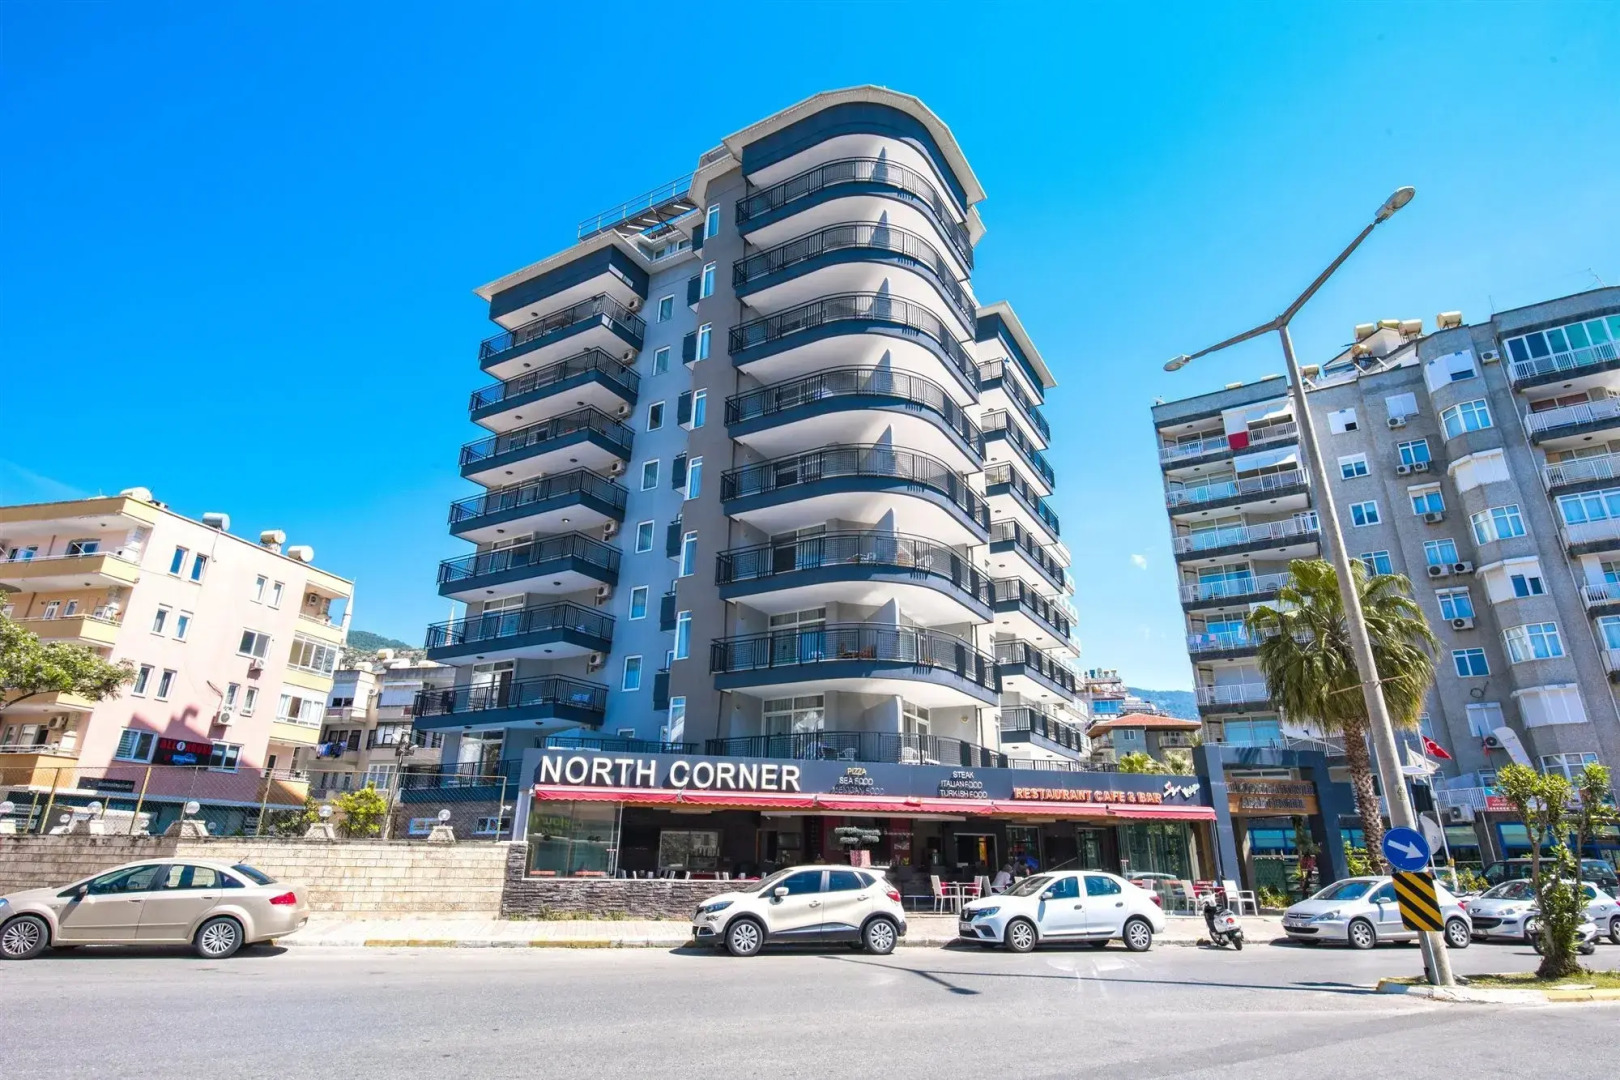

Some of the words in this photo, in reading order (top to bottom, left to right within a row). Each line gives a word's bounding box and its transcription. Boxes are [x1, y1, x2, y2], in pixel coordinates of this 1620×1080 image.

[540, 756, 656, 786] NORTH
[669, 760, 801, 792] CORNER
[847, 767, 867, 776] PIZZA
[952, 770, 975, 779] STEAK
[839, 776, 853, 785] SEA
[854, 777, 874, 786] FOOD
[940, 780, 965, 788] ITALIAN
[965, 781, 983, 789] FOOD
[940, 789, 969, 798] TURKISH
[969, 790, 988, 799] FOOD
[1013, 787, 1092, 802] RESTAURANT
[1094, 790, 1126, 803] CAFE
[1127, 791, 1137, 804] &
[1137, 792, 1163, 805] BAR
